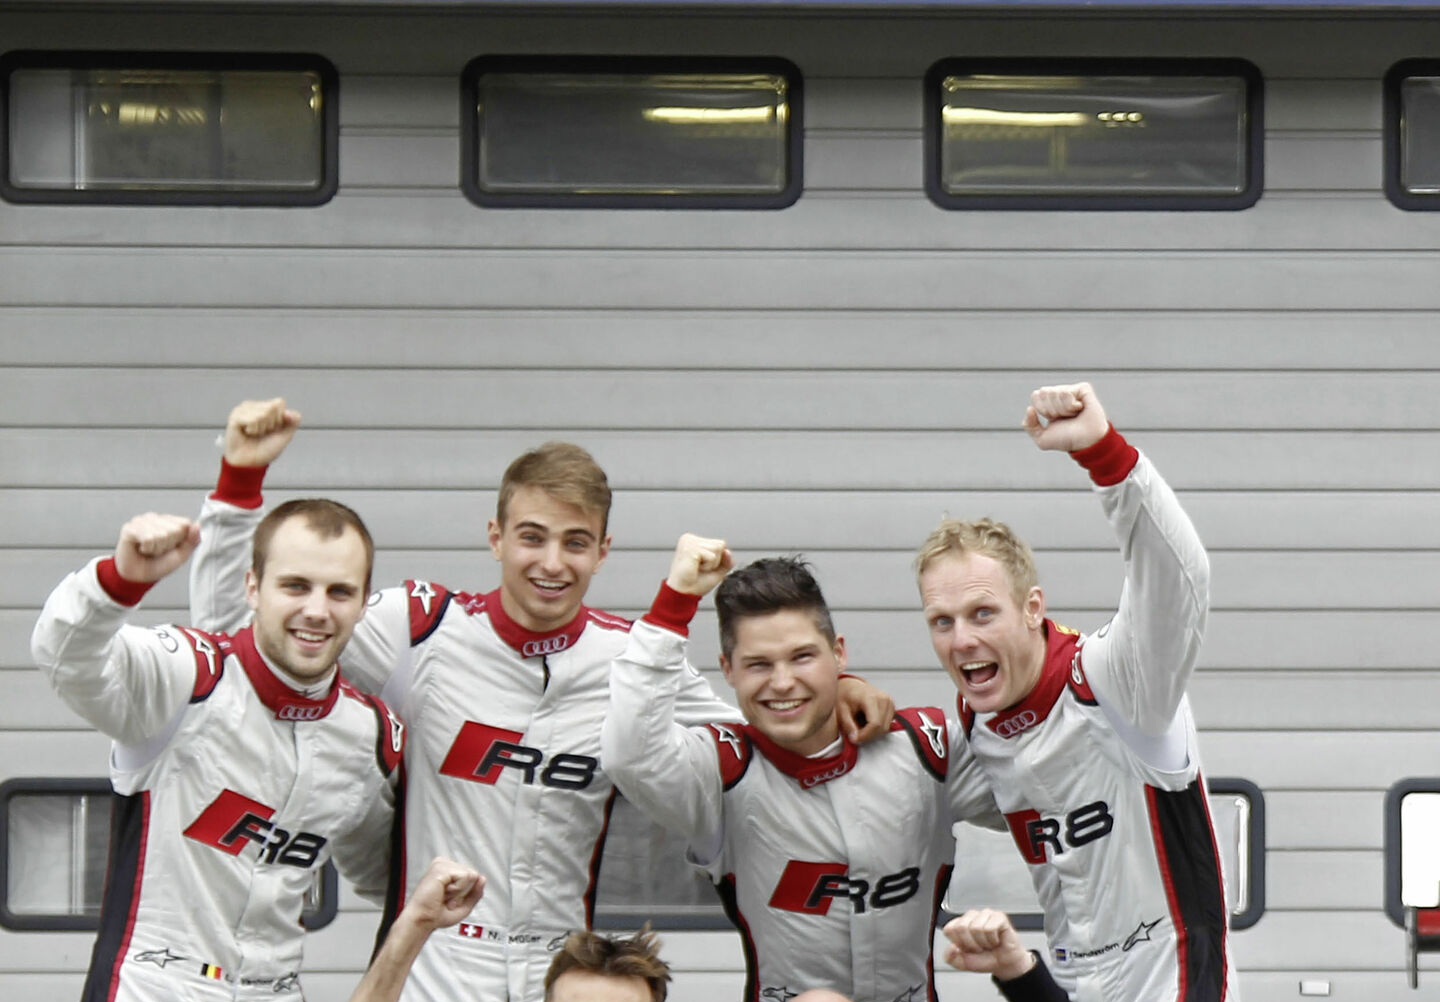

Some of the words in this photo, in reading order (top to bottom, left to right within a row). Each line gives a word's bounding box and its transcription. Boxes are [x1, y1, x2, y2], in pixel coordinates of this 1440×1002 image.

[473, 739, 598, 790] R8
[218, 811, 328, 868] R8
[1027, 800, 1114, 855] R8
[804, 867, 920, 914] R8
